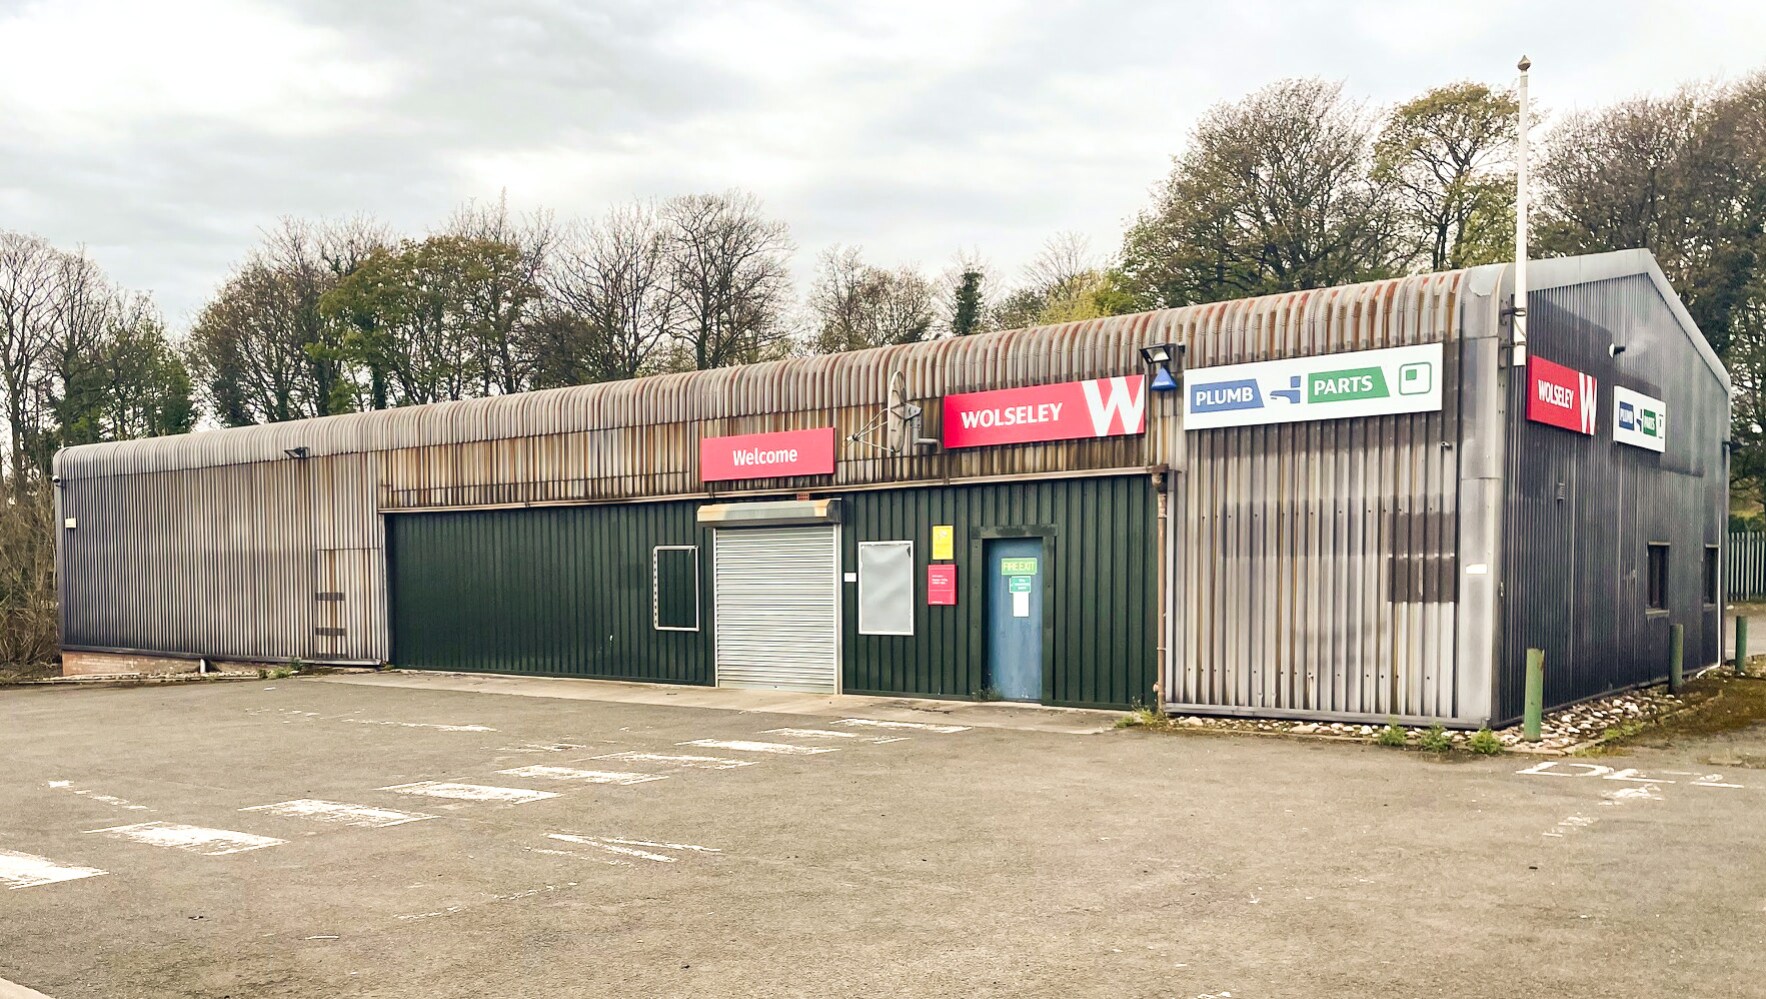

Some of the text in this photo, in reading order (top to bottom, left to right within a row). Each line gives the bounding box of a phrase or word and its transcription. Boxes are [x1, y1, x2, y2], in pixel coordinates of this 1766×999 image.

[1081, 374, 1145, 437] W
[1195, 375, 1374, 406] PLUMB PARTS
[1537, 379, 1574, 410] WOLSELEY
[1578, 371, 1597, 436] W
[960, 402, 1063, 429] WOLSELEY
[732, 447, 798, 466] Welcome
